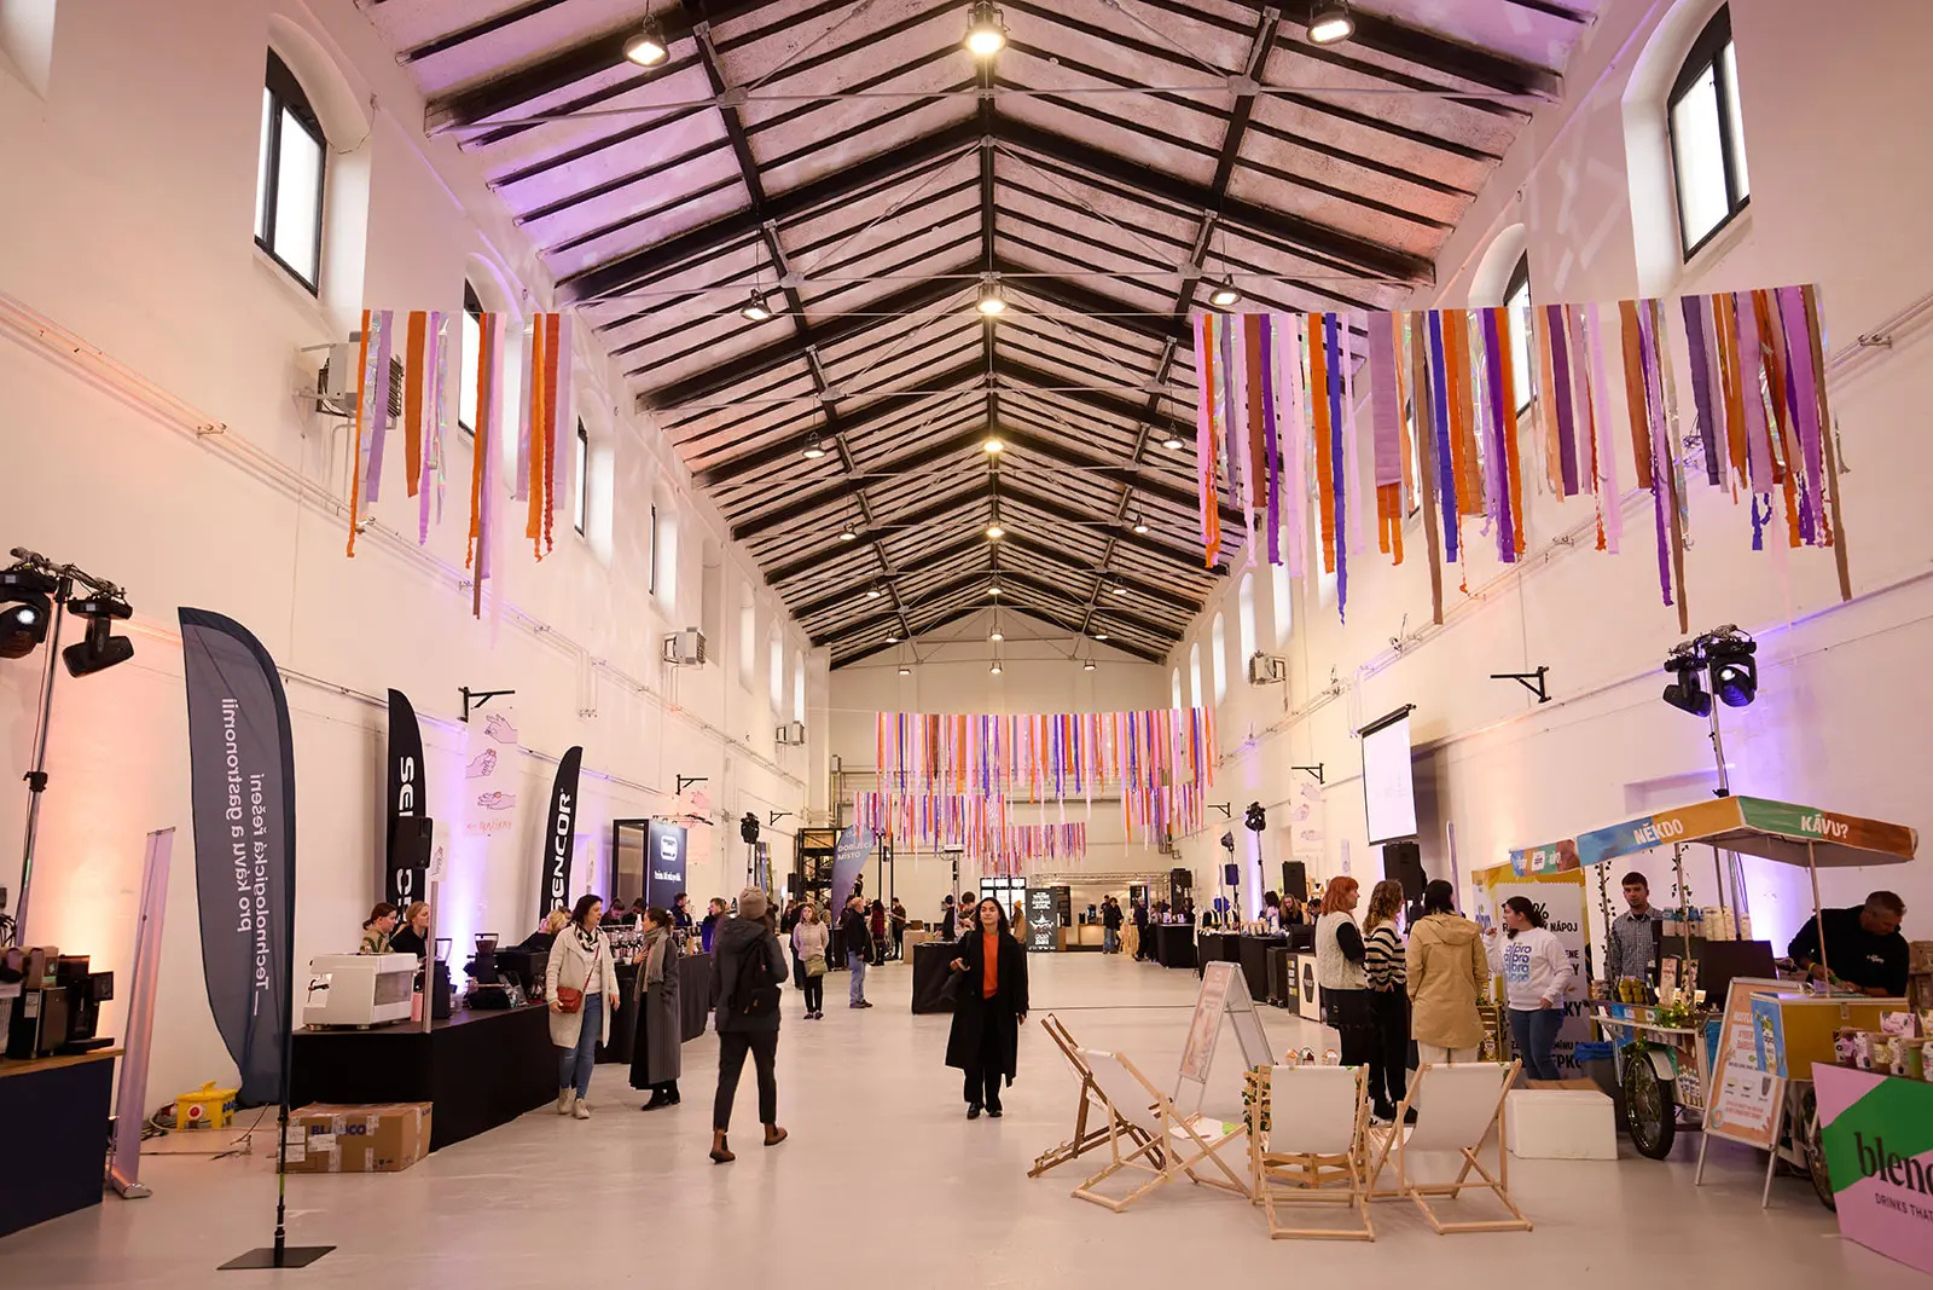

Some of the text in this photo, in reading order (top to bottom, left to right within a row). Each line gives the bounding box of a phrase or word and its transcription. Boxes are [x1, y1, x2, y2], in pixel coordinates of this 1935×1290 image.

[1632, 817, 1684, 845] NĚKDO
[1800, 813, 1849, 839] KÁVU?
[550, 791, 572, 911] SENCOR
[1550, 920, 1578, 932] NÁPOJ
[1875, 1192, 1908, 1214] DRINKS
